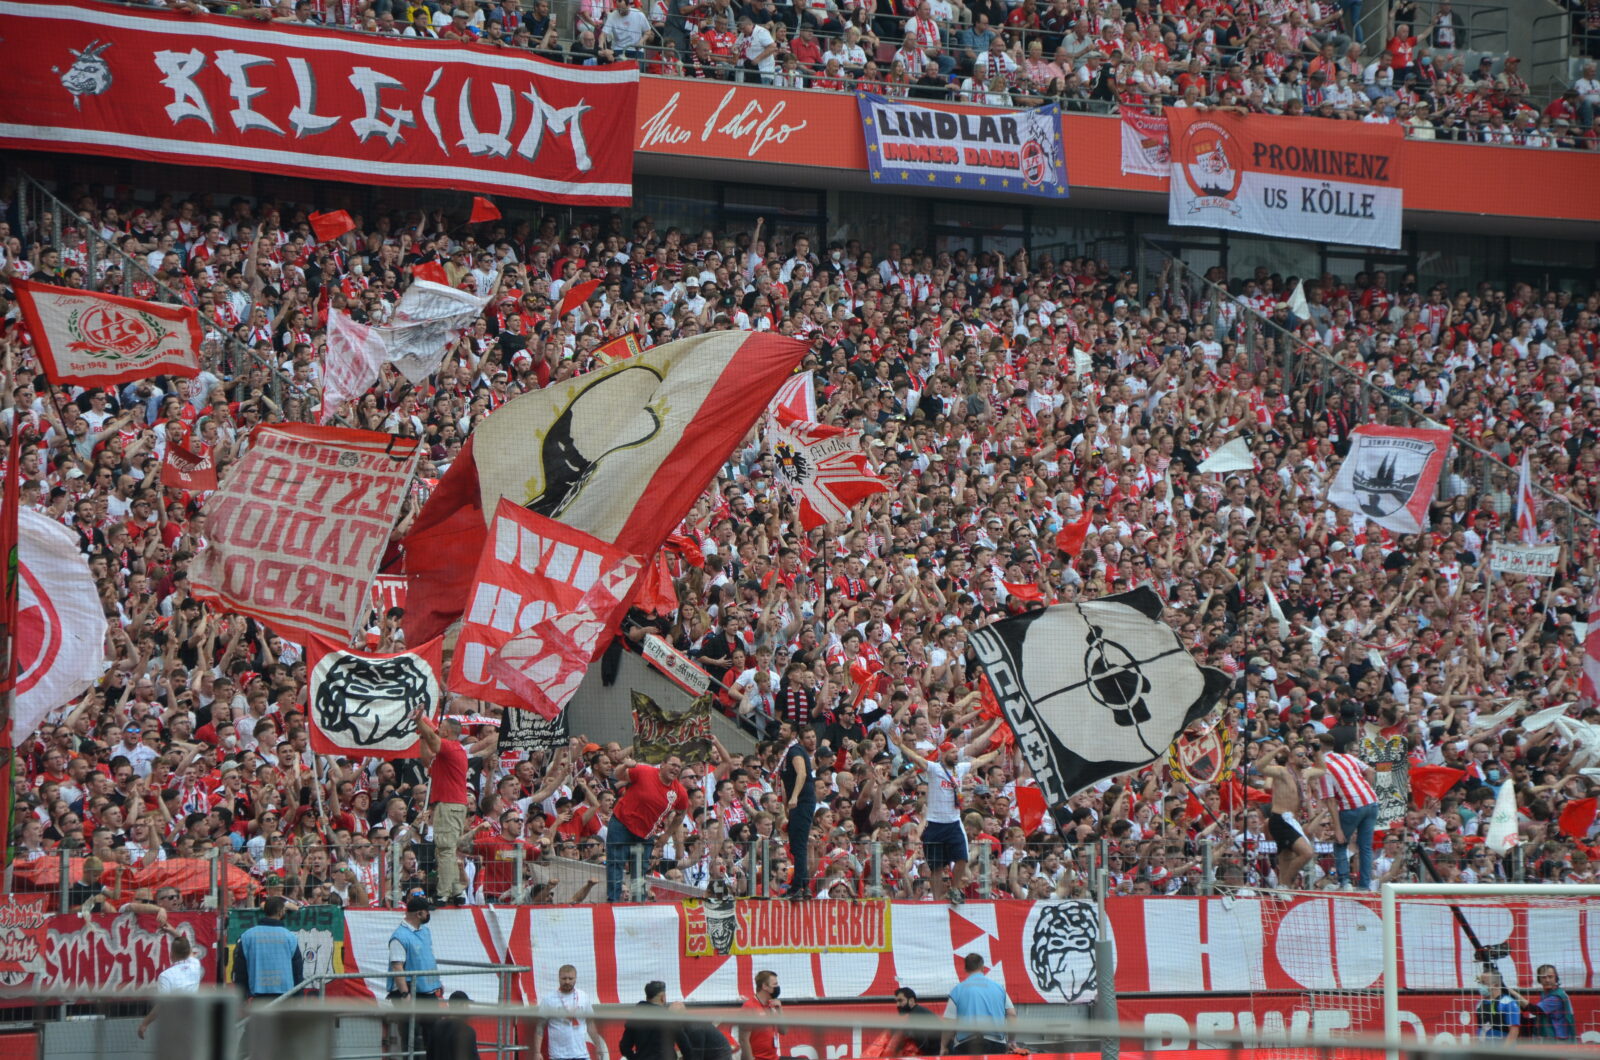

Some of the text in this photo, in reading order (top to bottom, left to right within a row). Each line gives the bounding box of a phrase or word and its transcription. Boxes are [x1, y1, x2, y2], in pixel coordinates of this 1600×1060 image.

[152, 47, 594, 174] BELGIUM
[877, 108, 1021, 146] LINDLAR
[882, 142, 1020, 171] IMMER DABEI
[1252, 141, 1390, 182] PROMINENZ
[1263, 183, 1376, 220] US KÖLLE
[734, 898, 886, 950] STADIONVERBOT
